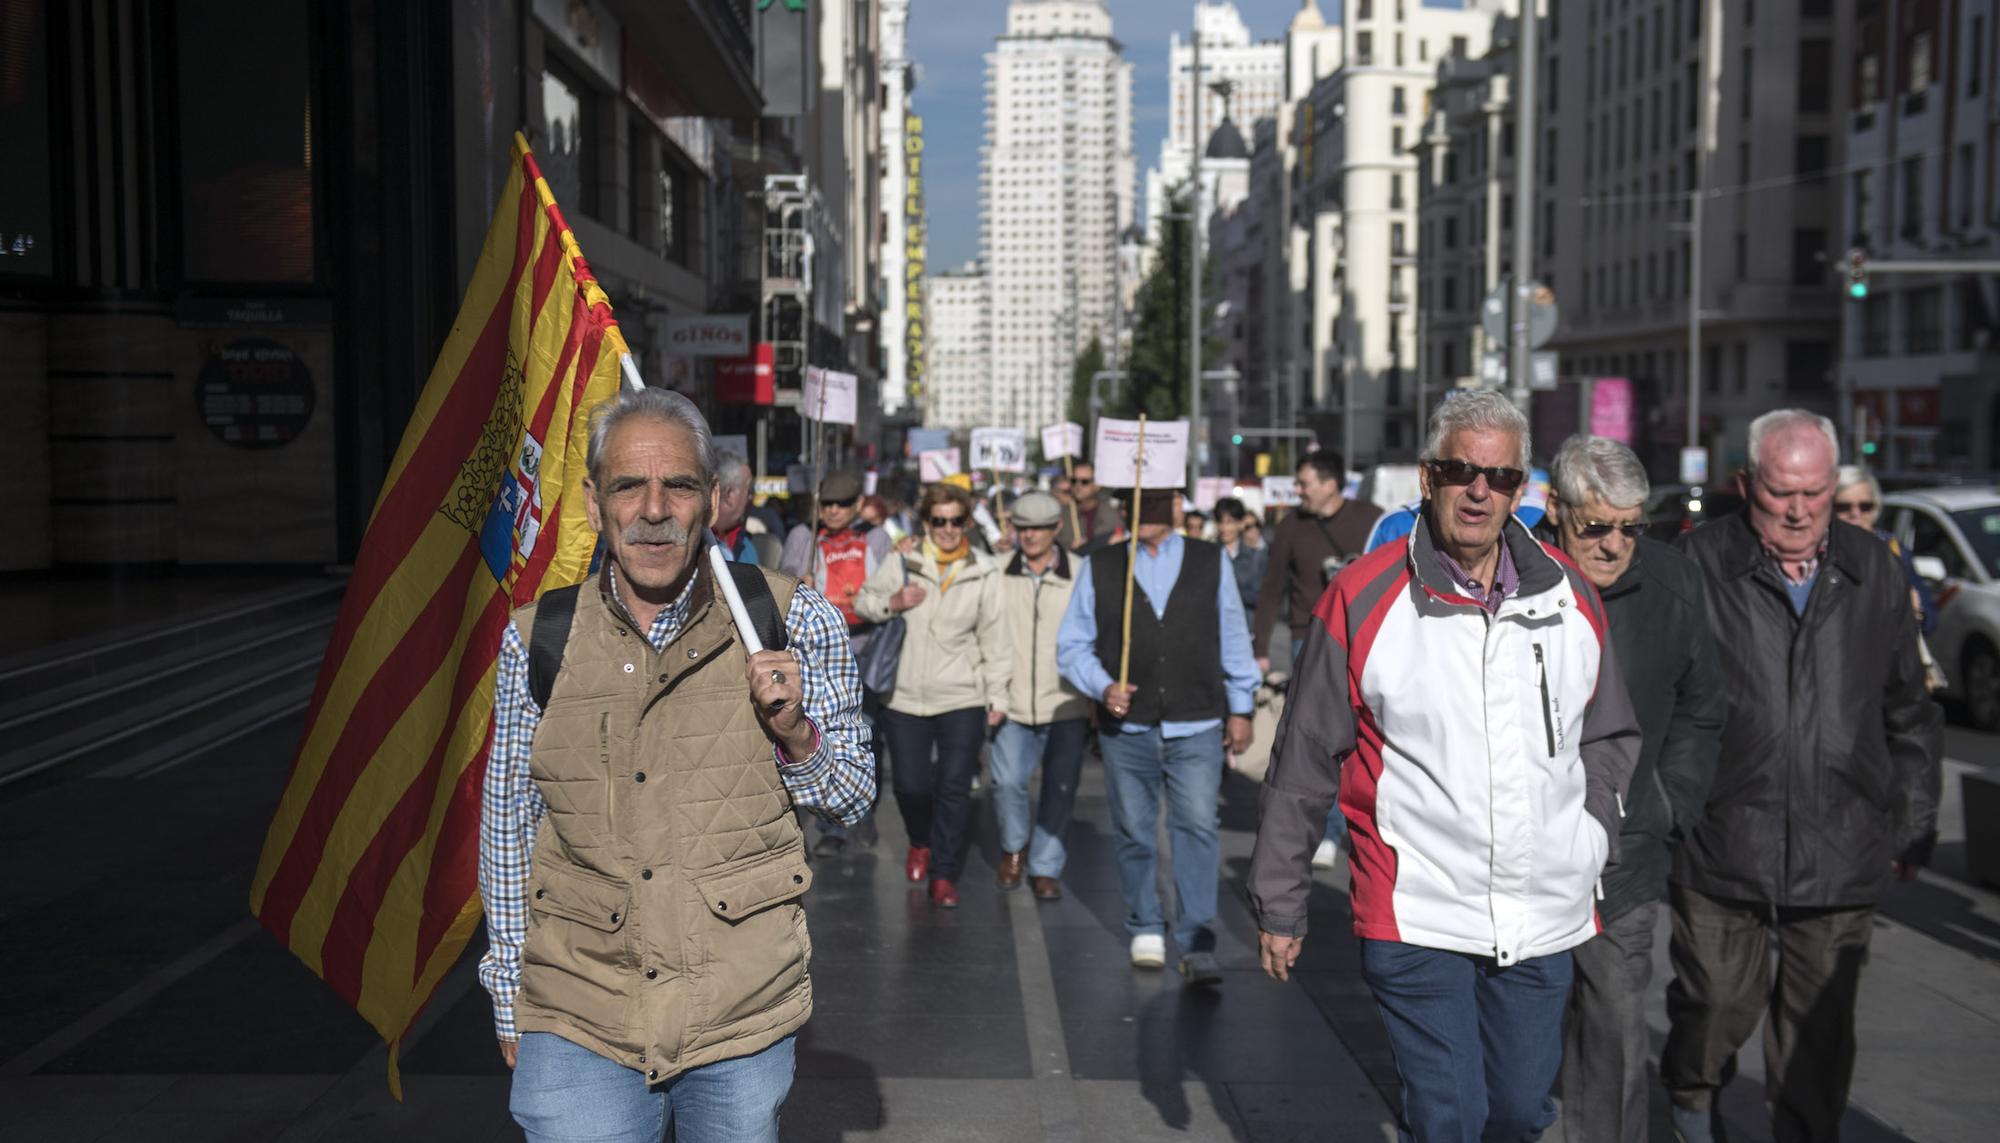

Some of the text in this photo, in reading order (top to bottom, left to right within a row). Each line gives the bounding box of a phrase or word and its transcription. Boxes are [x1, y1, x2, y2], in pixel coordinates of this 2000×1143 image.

[905, 116, 925, 397] HOTEL EMPERADOR
[227, 309, 284, 321] TAQUILLA
[672, 326, 743, 345] GINOS
